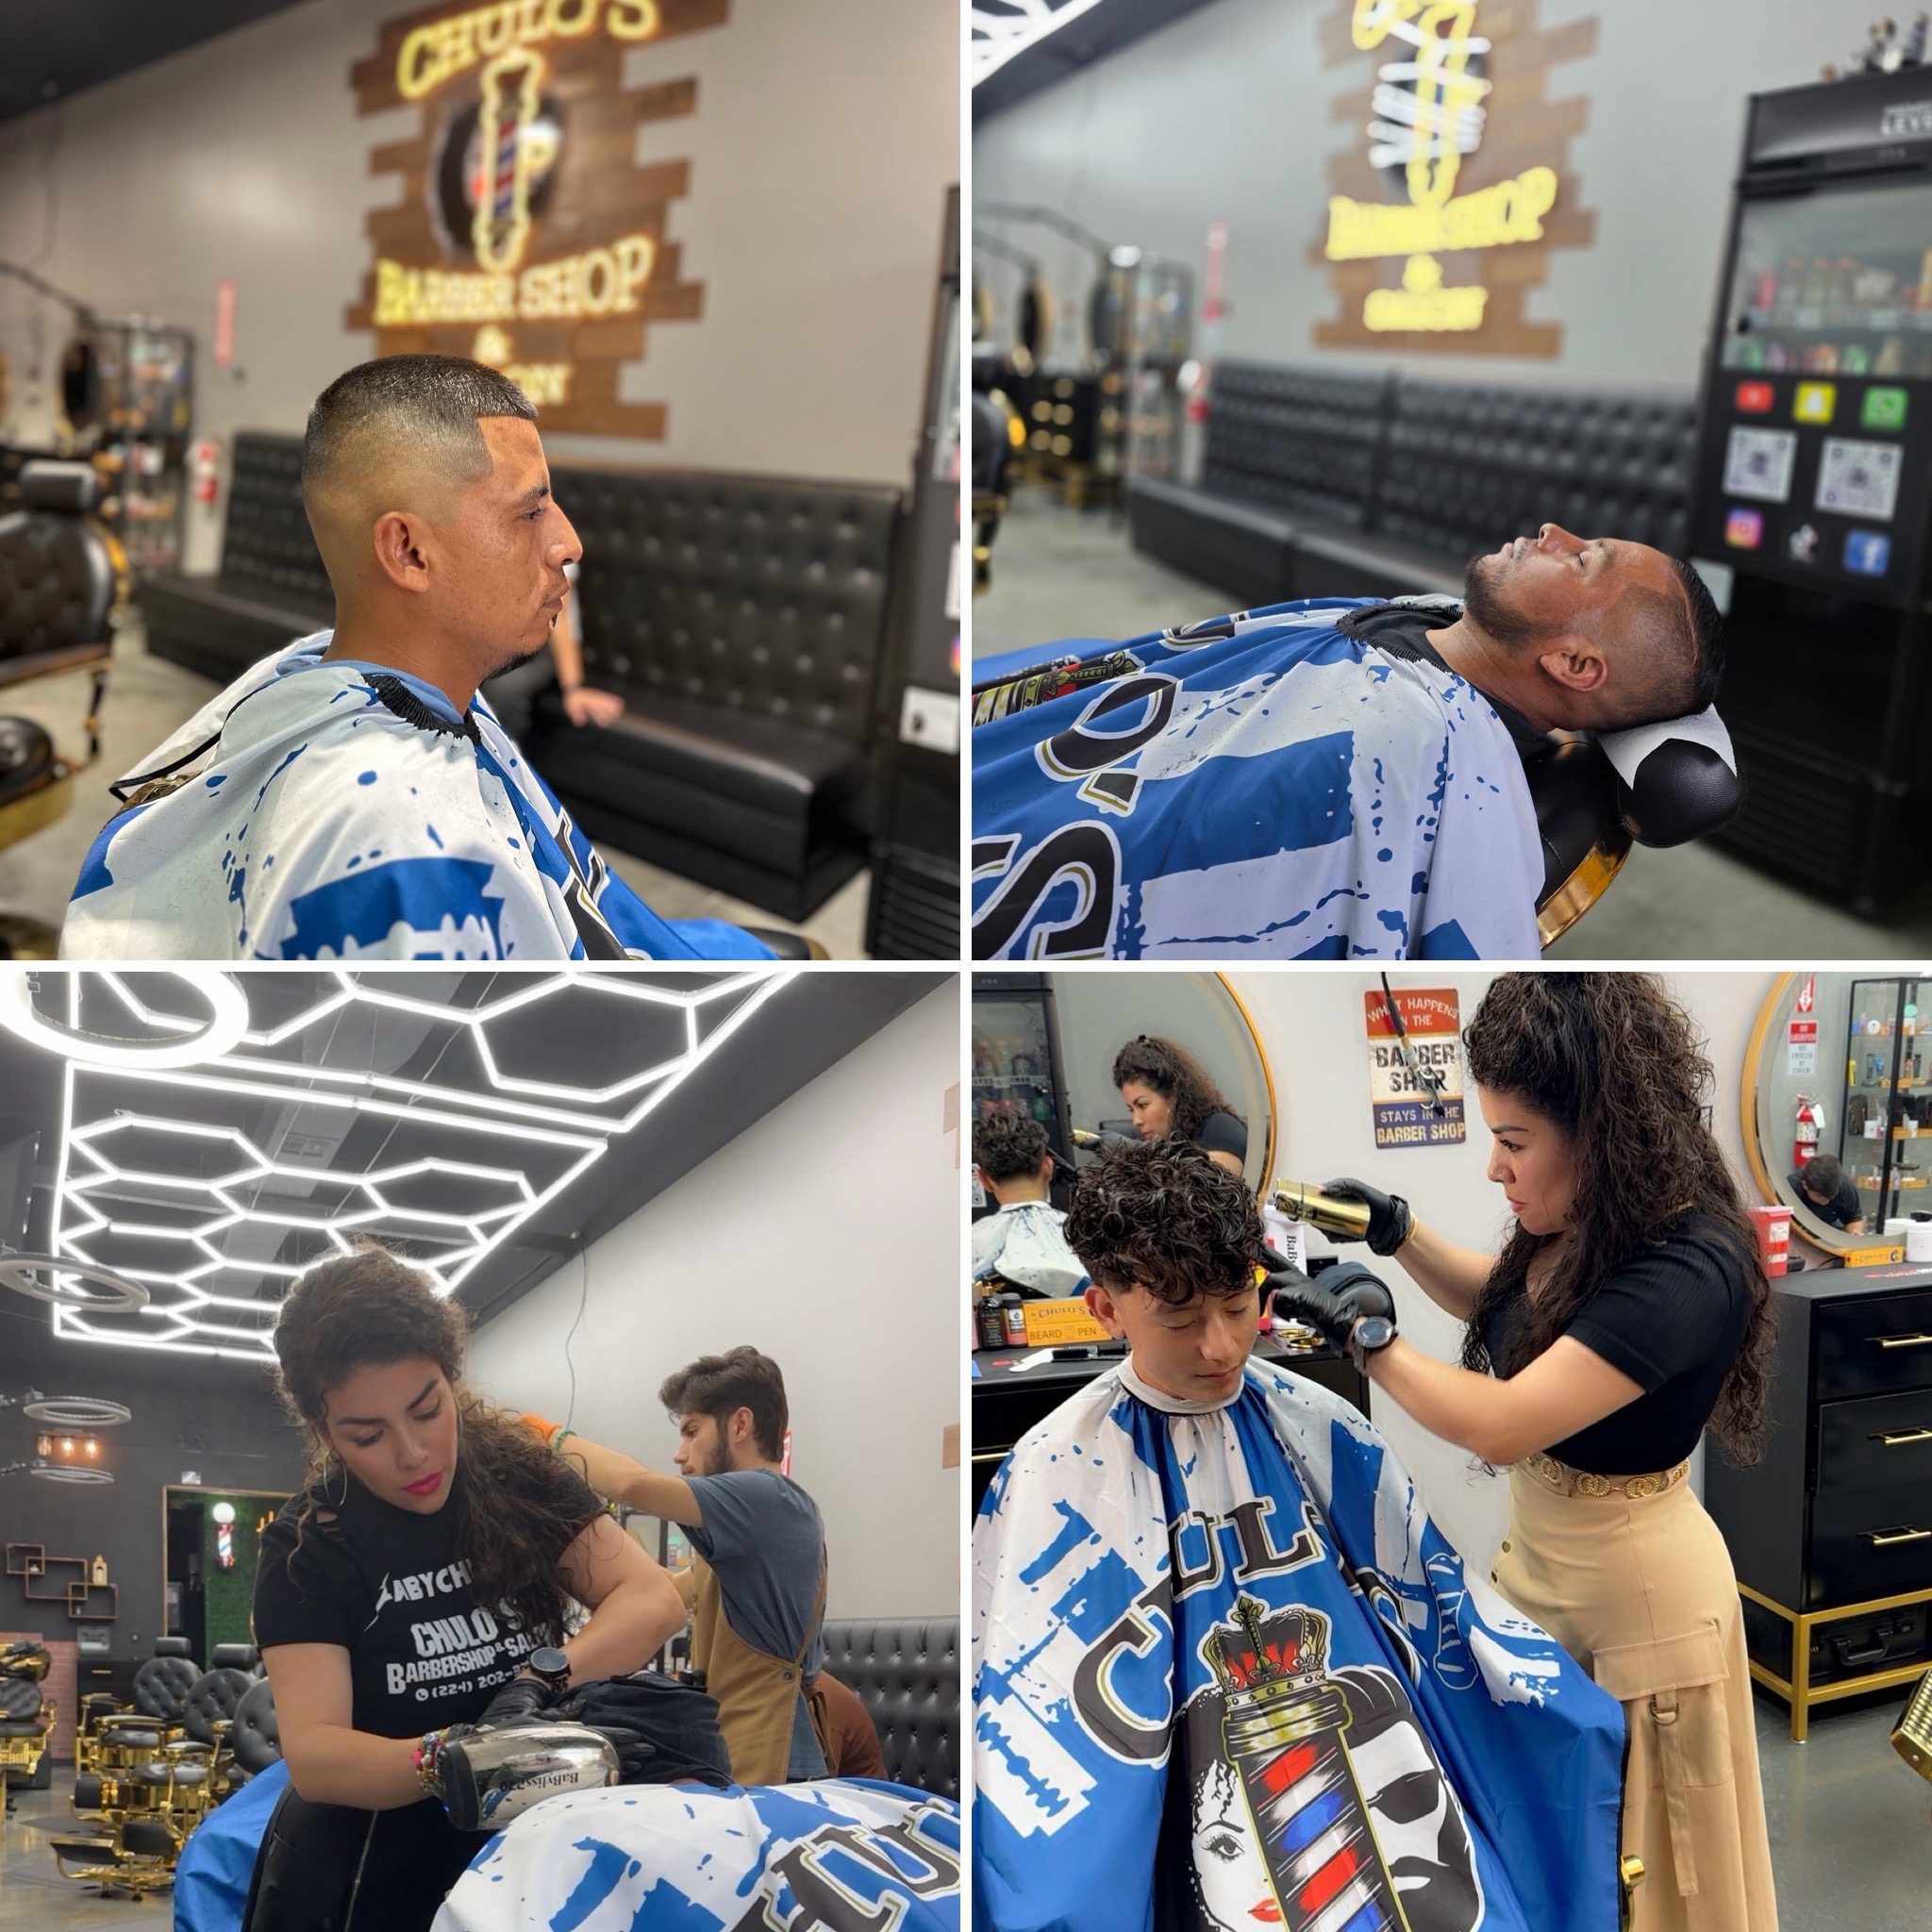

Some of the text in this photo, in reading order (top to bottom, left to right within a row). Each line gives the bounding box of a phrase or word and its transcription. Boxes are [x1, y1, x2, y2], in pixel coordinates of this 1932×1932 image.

[396, 0, 659, 99] CHULOS
[375, 235, 654, 325] BARBER SHOP
[1368, 998, 1459, 1023] WHT HAPPENS
[1412, 1015, 1433, 1026] THE
[1375, 1043, 1455, 1068] BABER
[1380, 1107, 1459, 1123] STAYS IN HE
[1376, 1123, 1465, 1144] BARBER SHOP
[1039, 1306, 1086, 1319] CHULO'S
[1029, 1327, 1097, 1341] BEARD PEN
[409, 1596, 524, 1657] CHULOS
[432, 1681, 473, 1698] (224)
